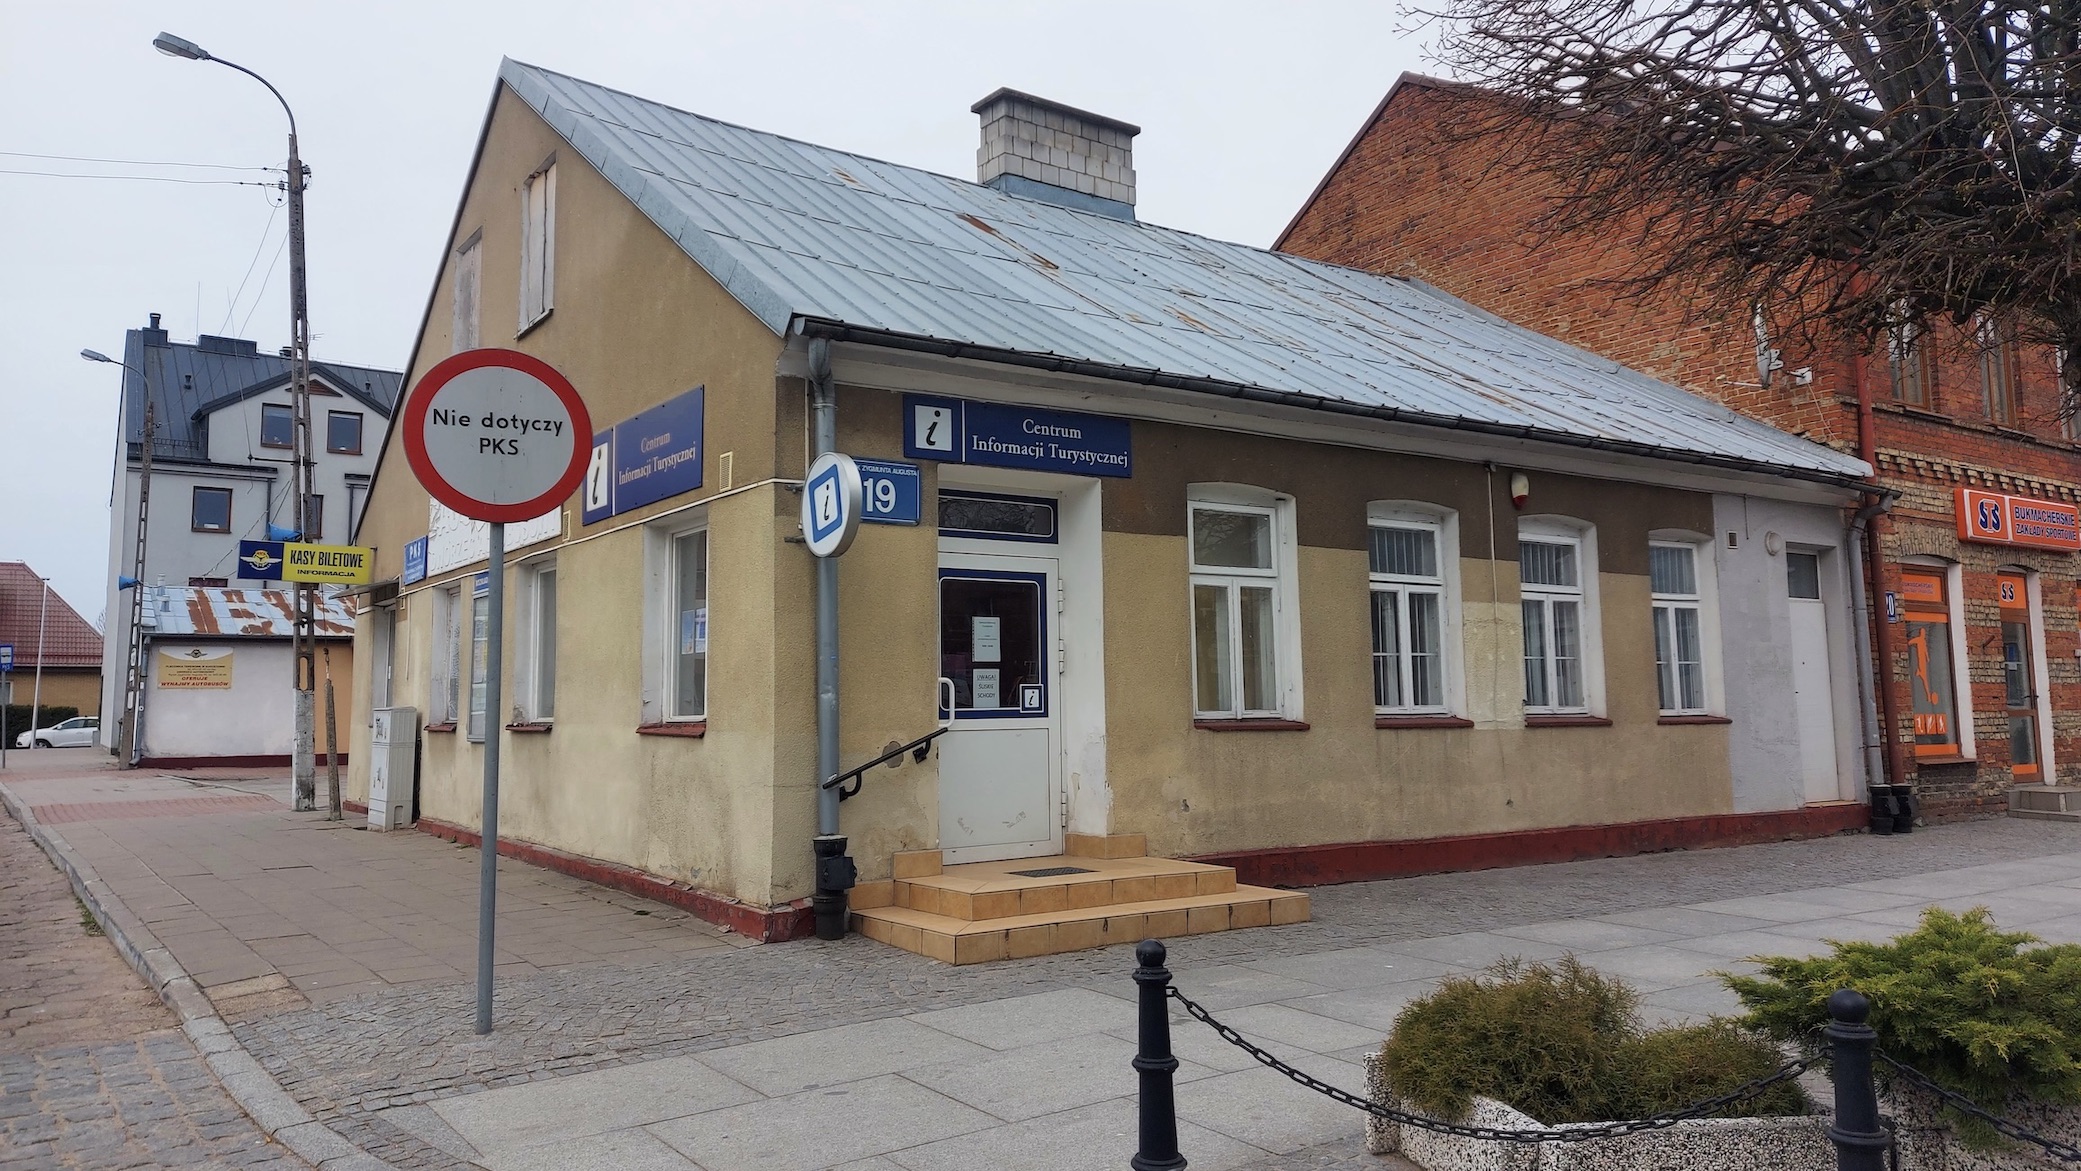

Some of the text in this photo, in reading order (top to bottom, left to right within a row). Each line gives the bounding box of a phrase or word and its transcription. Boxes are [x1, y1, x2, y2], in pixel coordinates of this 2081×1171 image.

[433, 408, 563, 437] Nie dotyczy
[1022, 418, 1083, 440] Centrum
[479, 437, 519, 456] PKS
[640, 432, 671, 454] Centrum
[972, 434, 1129, 468] Informacji Turystycznej
[618, 440, 696, 486] Informacji Turystycznej
[861, 465, 892, 474] ZYGMUNTA
[892, 468, 918, 477] AUGUSTA
[863, 478, 897, 514] 19
[2014, 506, 2076, 527] BUKMACHERSKIE
[2015, 523, 2077, 541] ZAKŁADY SPORTOWE
[290, 549, 364, 568] KASY BILETOWE
[297, 569, 356, 578] INFORMACJA
